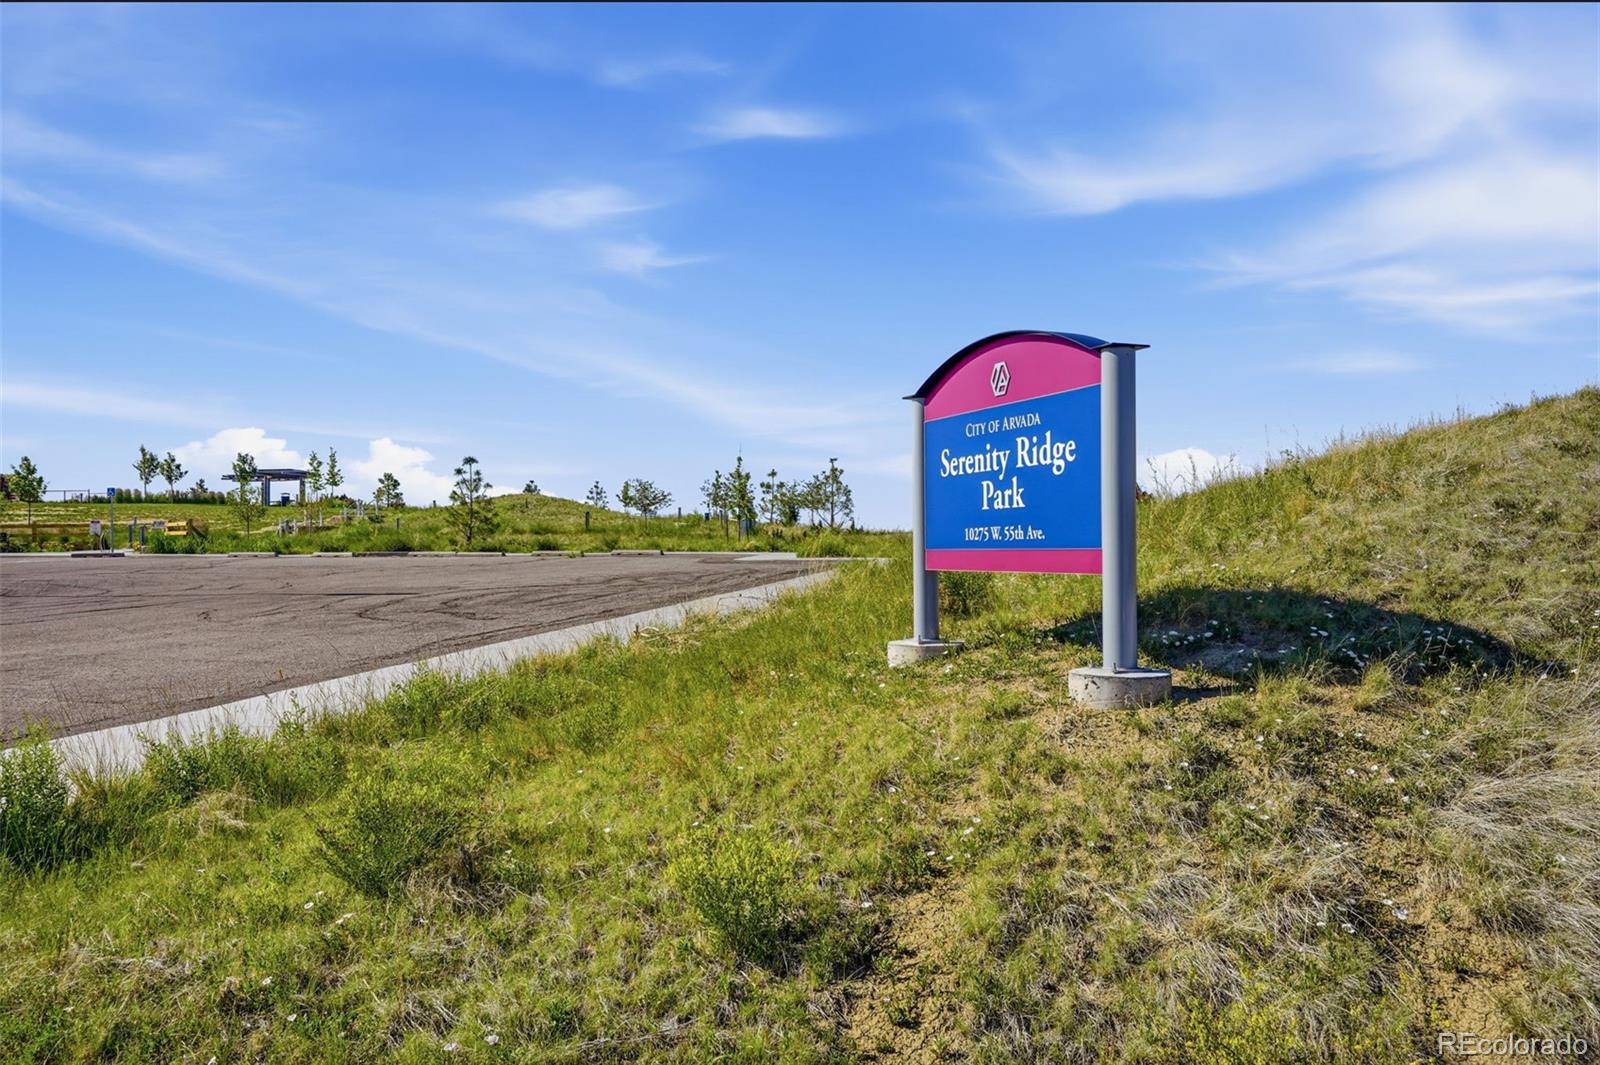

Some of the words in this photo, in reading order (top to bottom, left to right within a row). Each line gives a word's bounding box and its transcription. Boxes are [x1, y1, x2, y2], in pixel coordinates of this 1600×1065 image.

[965, 422, 986, 438] CITY
[987, 420, 1000, 434] OF
[1002, 412, 1041, 431] ARVADA
[940, 444, 1010, 481] Serenity
[1016, 430, 1077, 476] Ridge
[981, 476, 1026, 511] Park
[964, 527, 989, 541] 10275
[990, 527, 1002, 540] W.
[1003, 525, 1025, 540] 55th
[1026, 526, 1045, 540] Ave.
